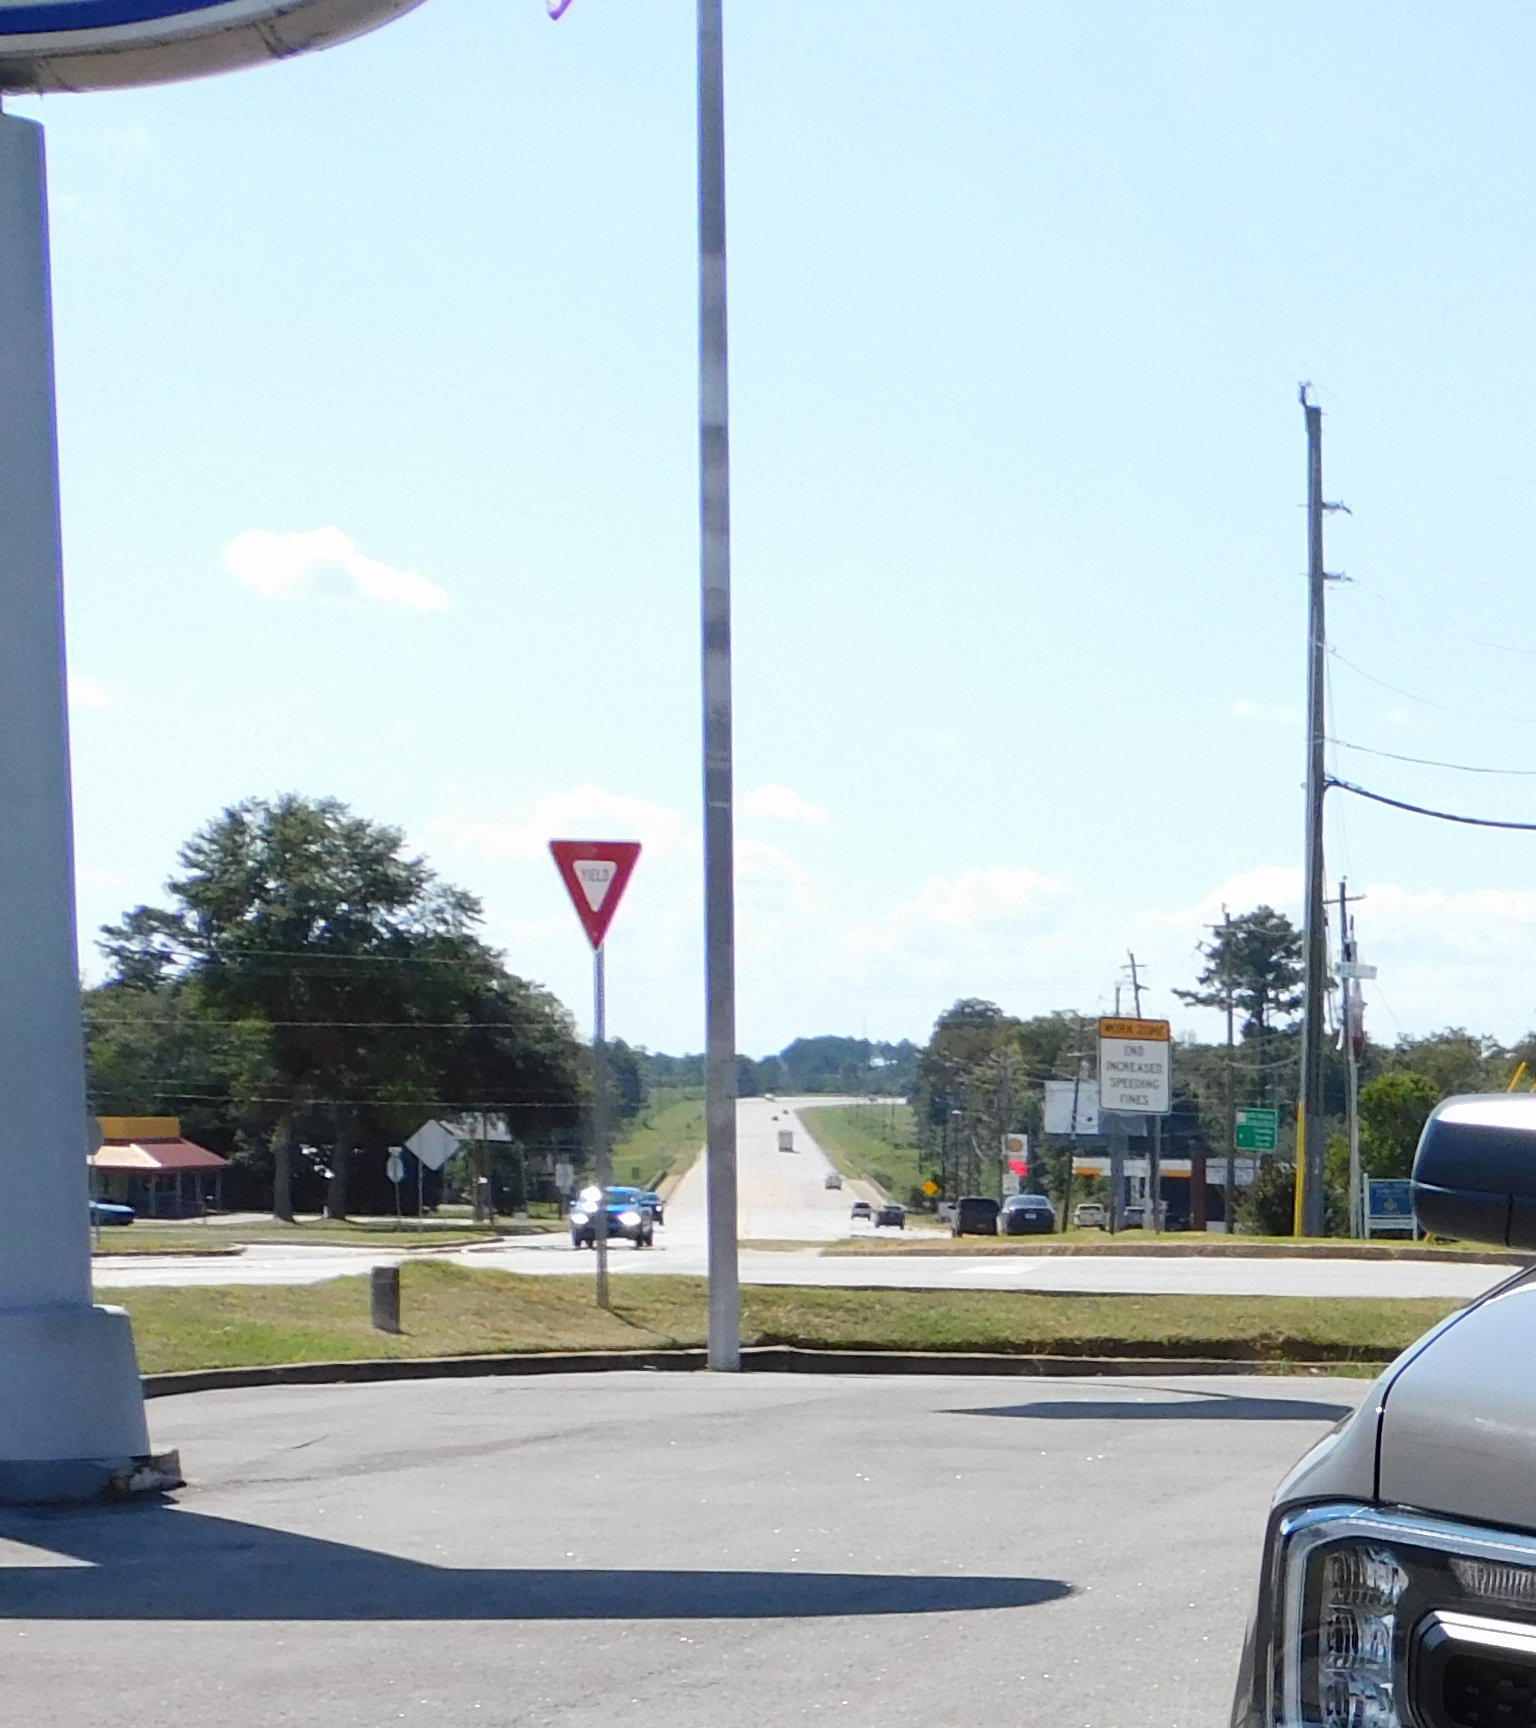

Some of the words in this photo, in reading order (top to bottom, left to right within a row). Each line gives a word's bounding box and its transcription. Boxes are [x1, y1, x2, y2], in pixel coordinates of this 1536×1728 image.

[1123, 1045, 1144, 1057] END
[1106, 1061, 1163, 1074] INCREASED
[1109, 1077, 1160, 1090] SPEEDING
[1119, 1094, 1150, 1106] FINES
